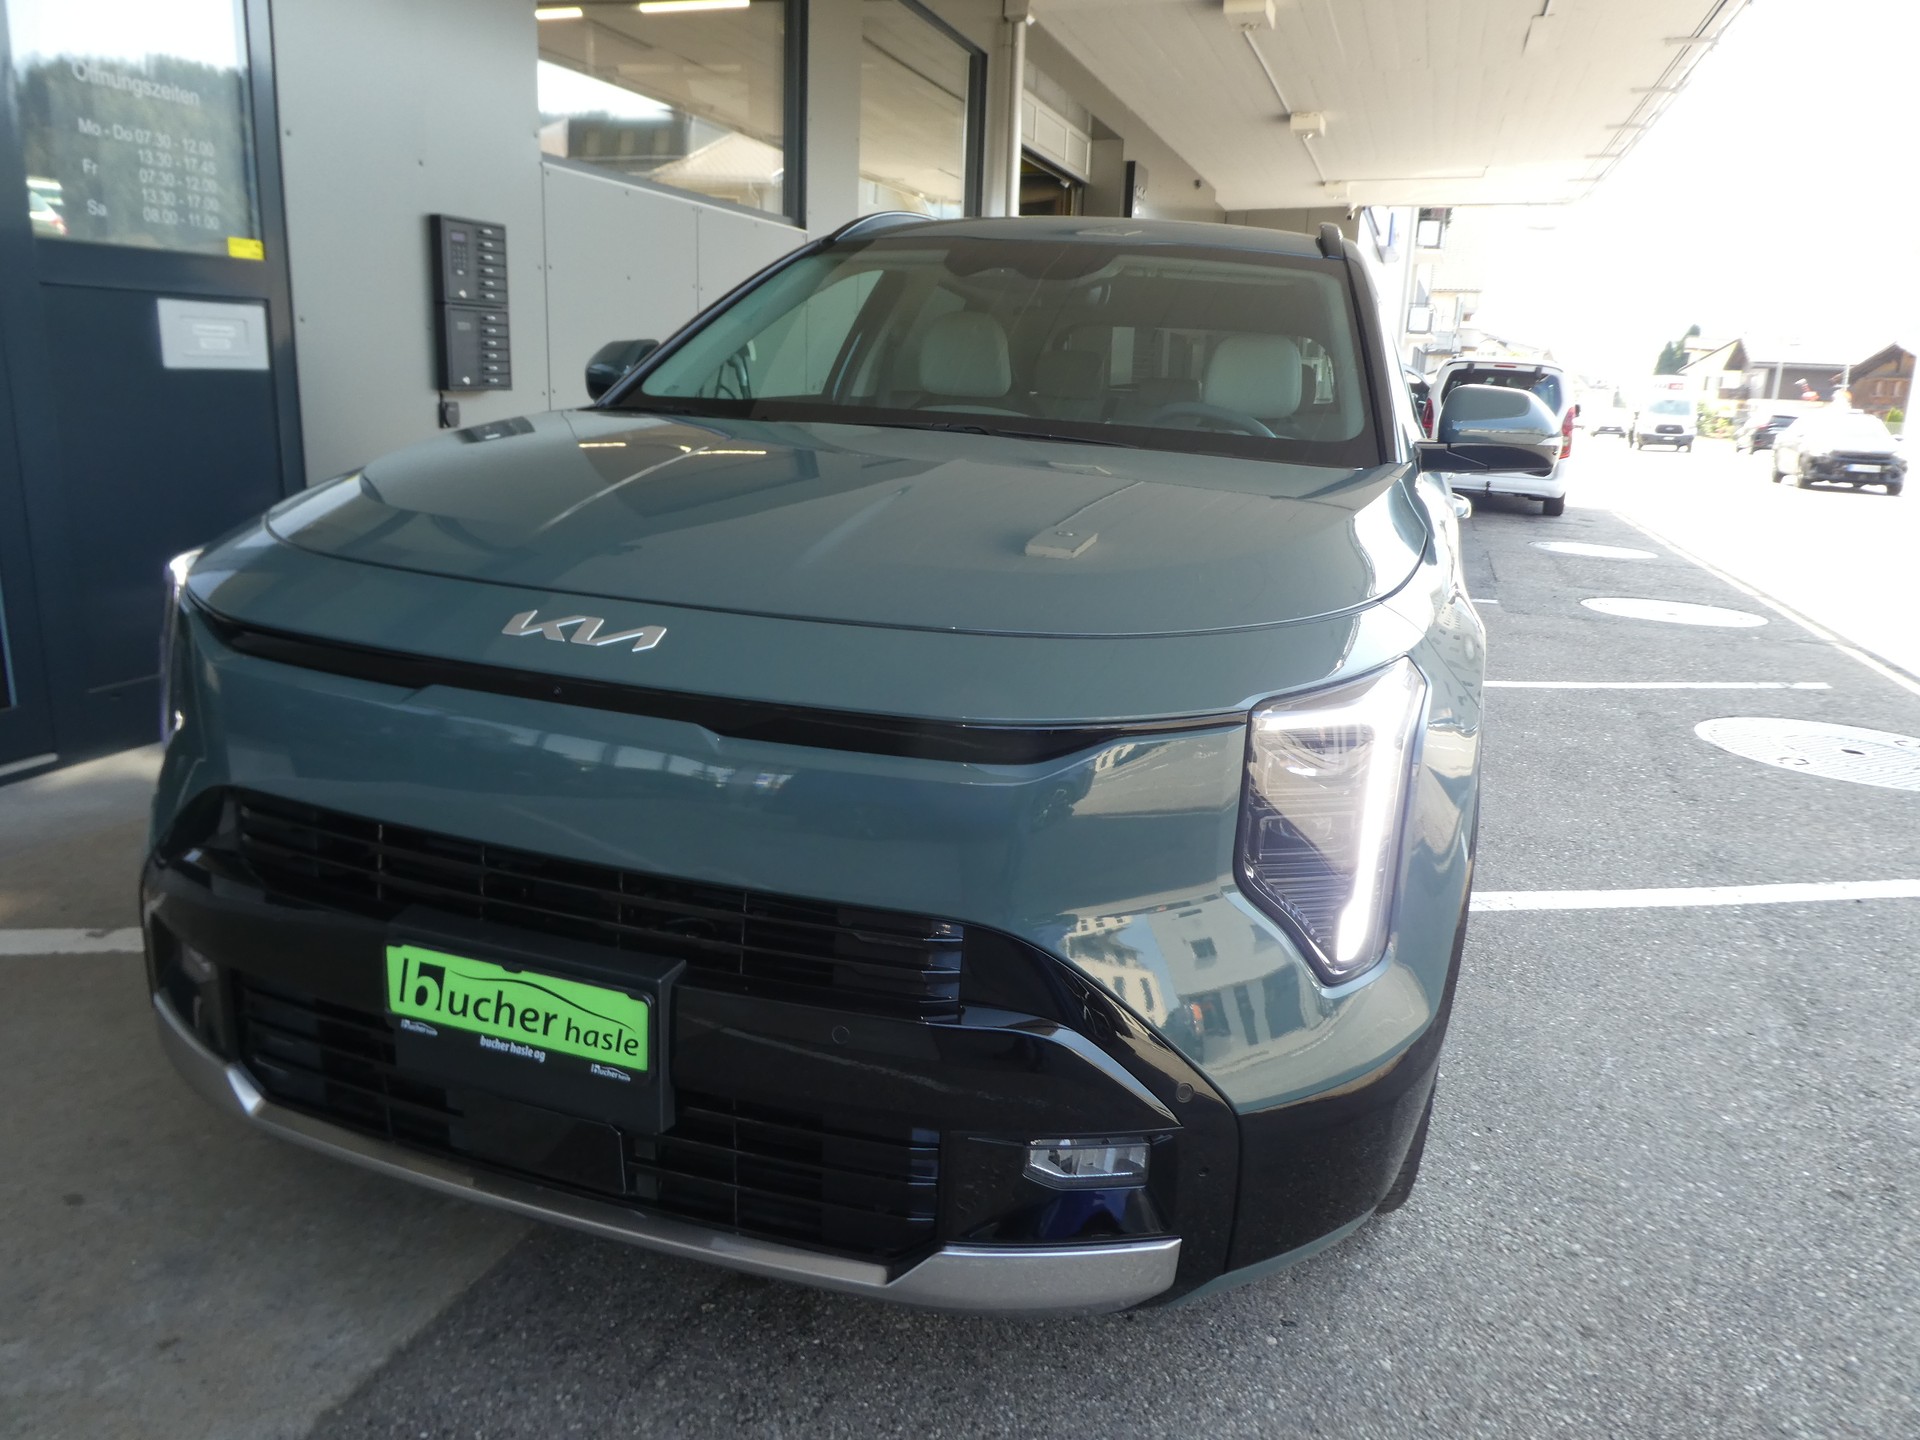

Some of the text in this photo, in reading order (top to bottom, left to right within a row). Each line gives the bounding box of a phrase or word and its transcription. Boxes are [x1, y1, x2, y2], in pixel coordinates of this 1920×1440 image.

[77, 117, 101, 137] Mo
[112, 123, 133, 142] Do
[82, 158, 98, 176] Fr
[86, 198, 108, 217] Sa
[400, 957, 639, 1057] bucher hasle
[480, 1034, 546, 1063] bucher hasle ag
